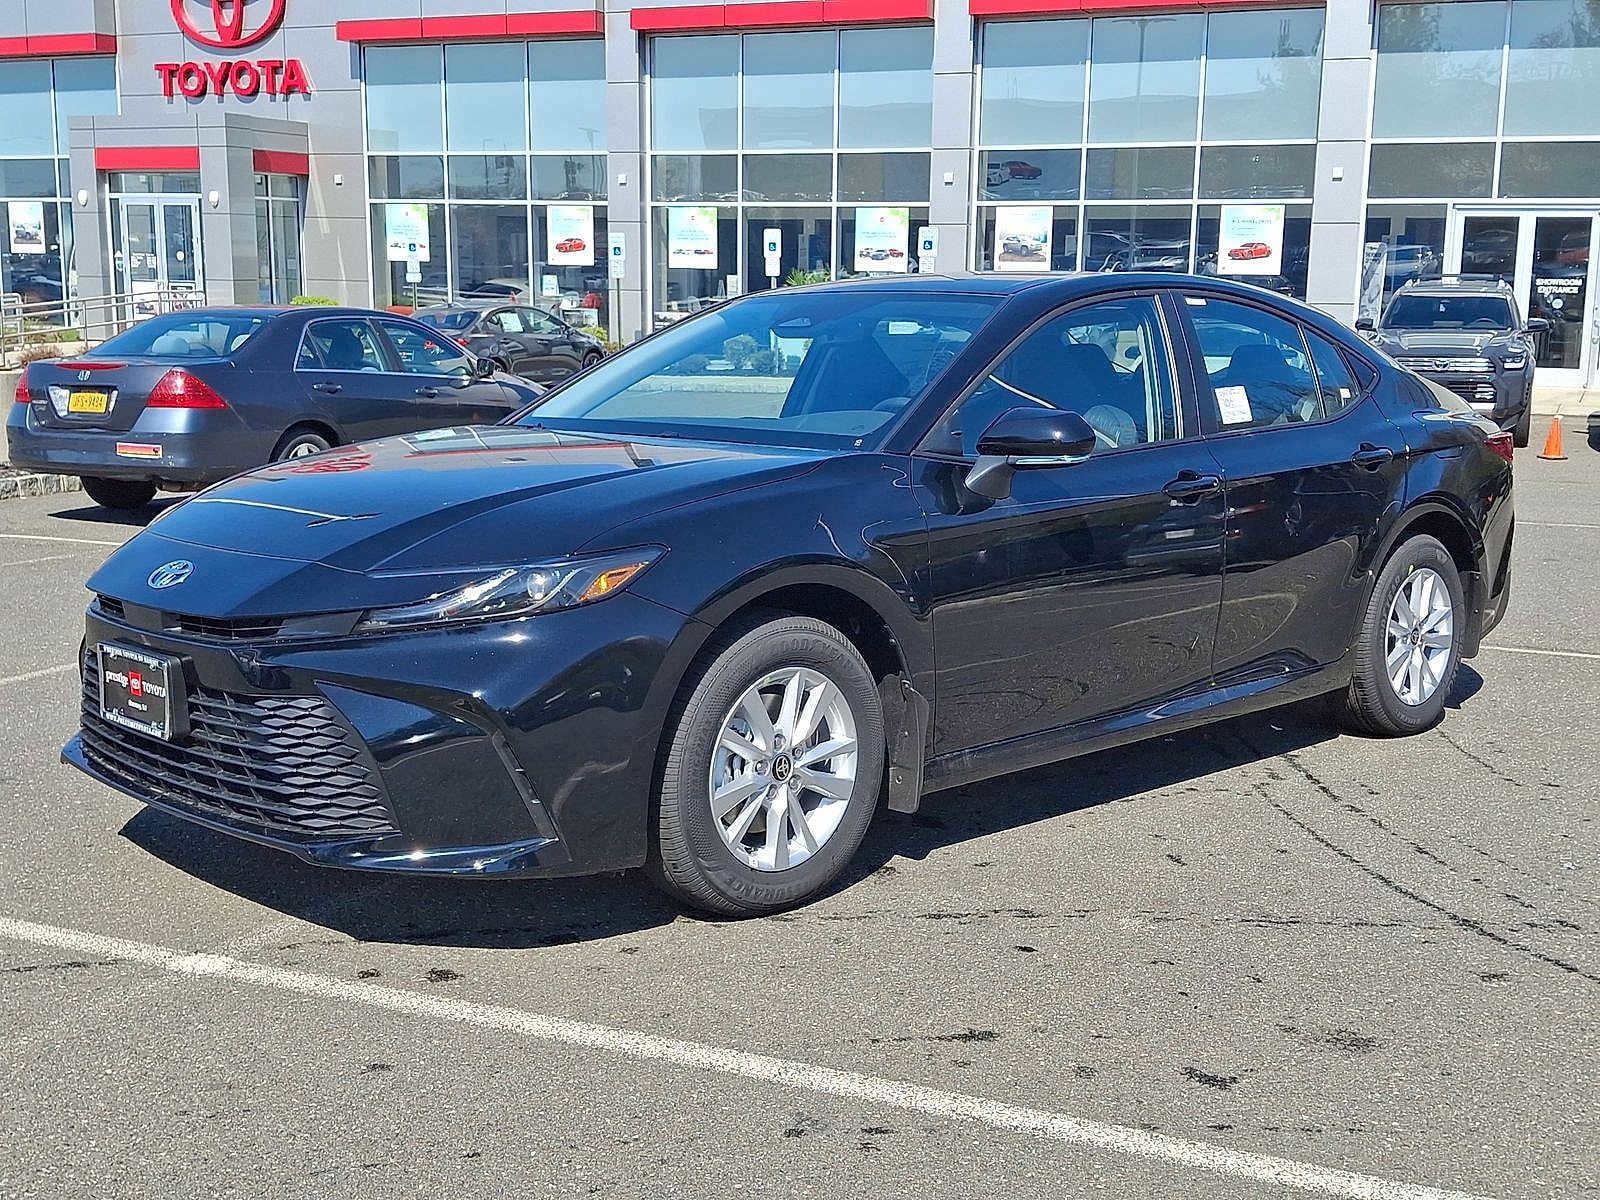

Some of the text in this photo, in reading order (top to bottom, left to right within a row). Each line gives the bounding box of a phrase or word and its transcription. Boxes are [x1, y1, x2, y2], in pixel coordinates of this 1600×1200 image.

[154, 59, 314, 98] TOYOTA
[1535, 278, 1583, 286] SHOWROOM
[1537, 286, 1579, 294] ENTRANCE
[105, 671, 166, 698] prestige TOYOTA
[723, 874, 800, 901] URANCE
